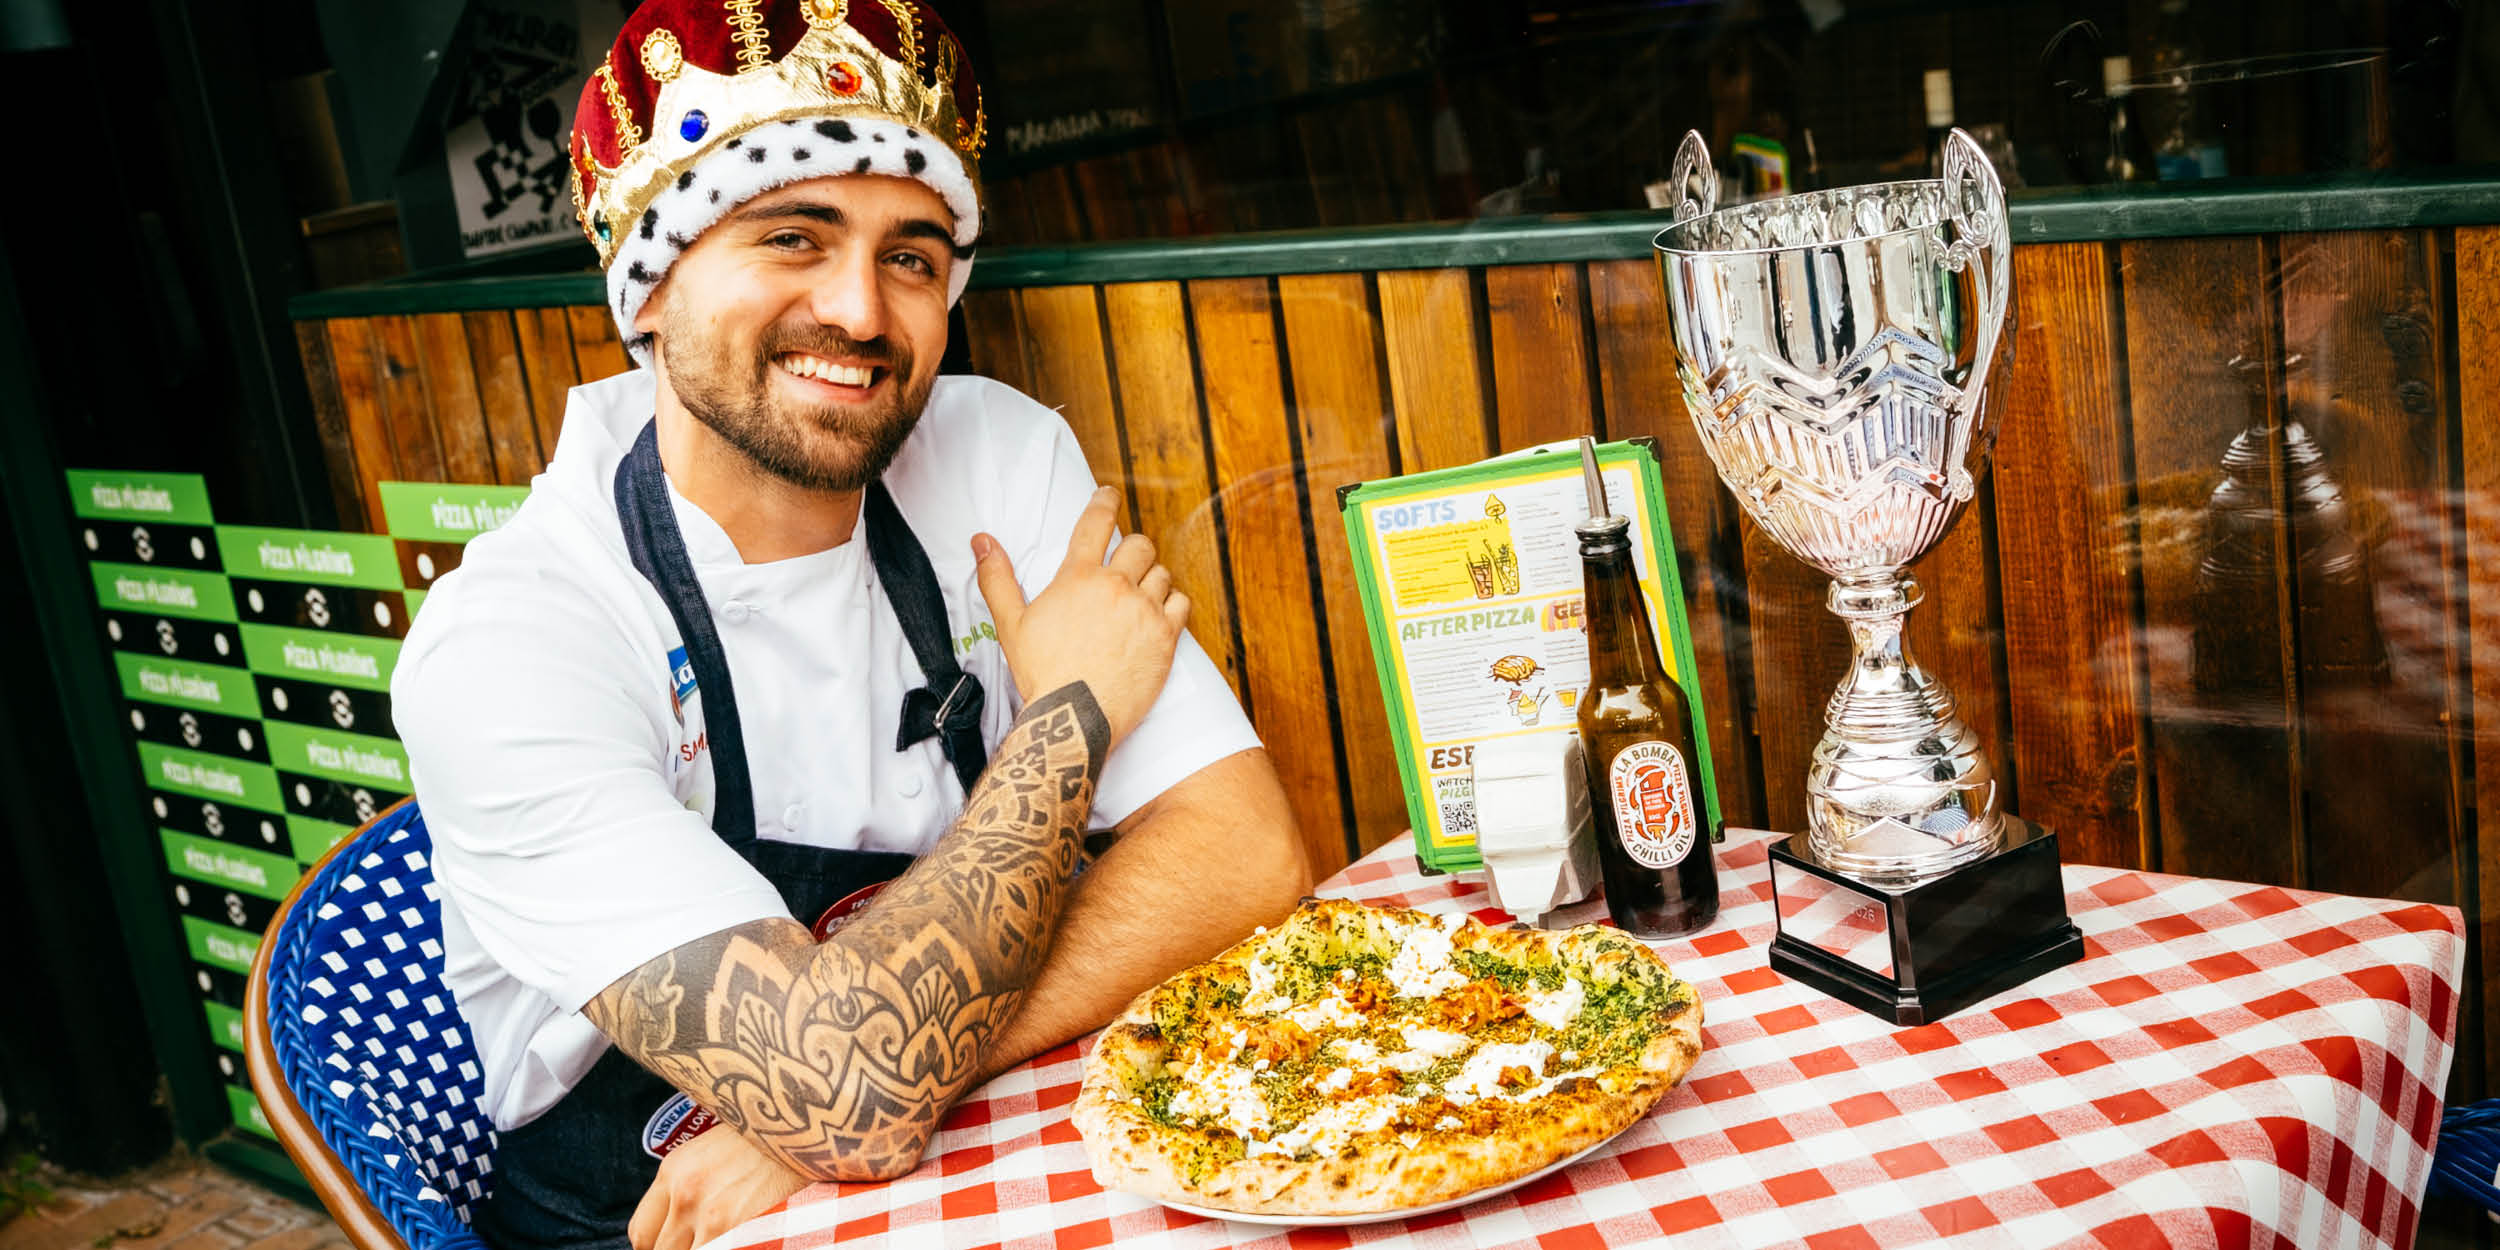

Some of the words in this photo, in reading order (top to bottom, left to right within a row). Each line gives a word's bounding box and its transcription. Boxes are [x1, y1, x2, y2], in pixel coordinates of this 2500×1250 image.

[1378, 500, 1456, 530] SOFTS
[1402, 614, 1468, 641] AFTER
[1471, 606, 1536, 632] PIZZA
[1616, 758, 1631, 773] LA
[1632, 746, 1675, 766] BOMBA
[1632, 843, 1674, 862] CHILLI
[1674, 833, 1691, 852] OIL
[653, 1099, 692, 1140] INSIEME
